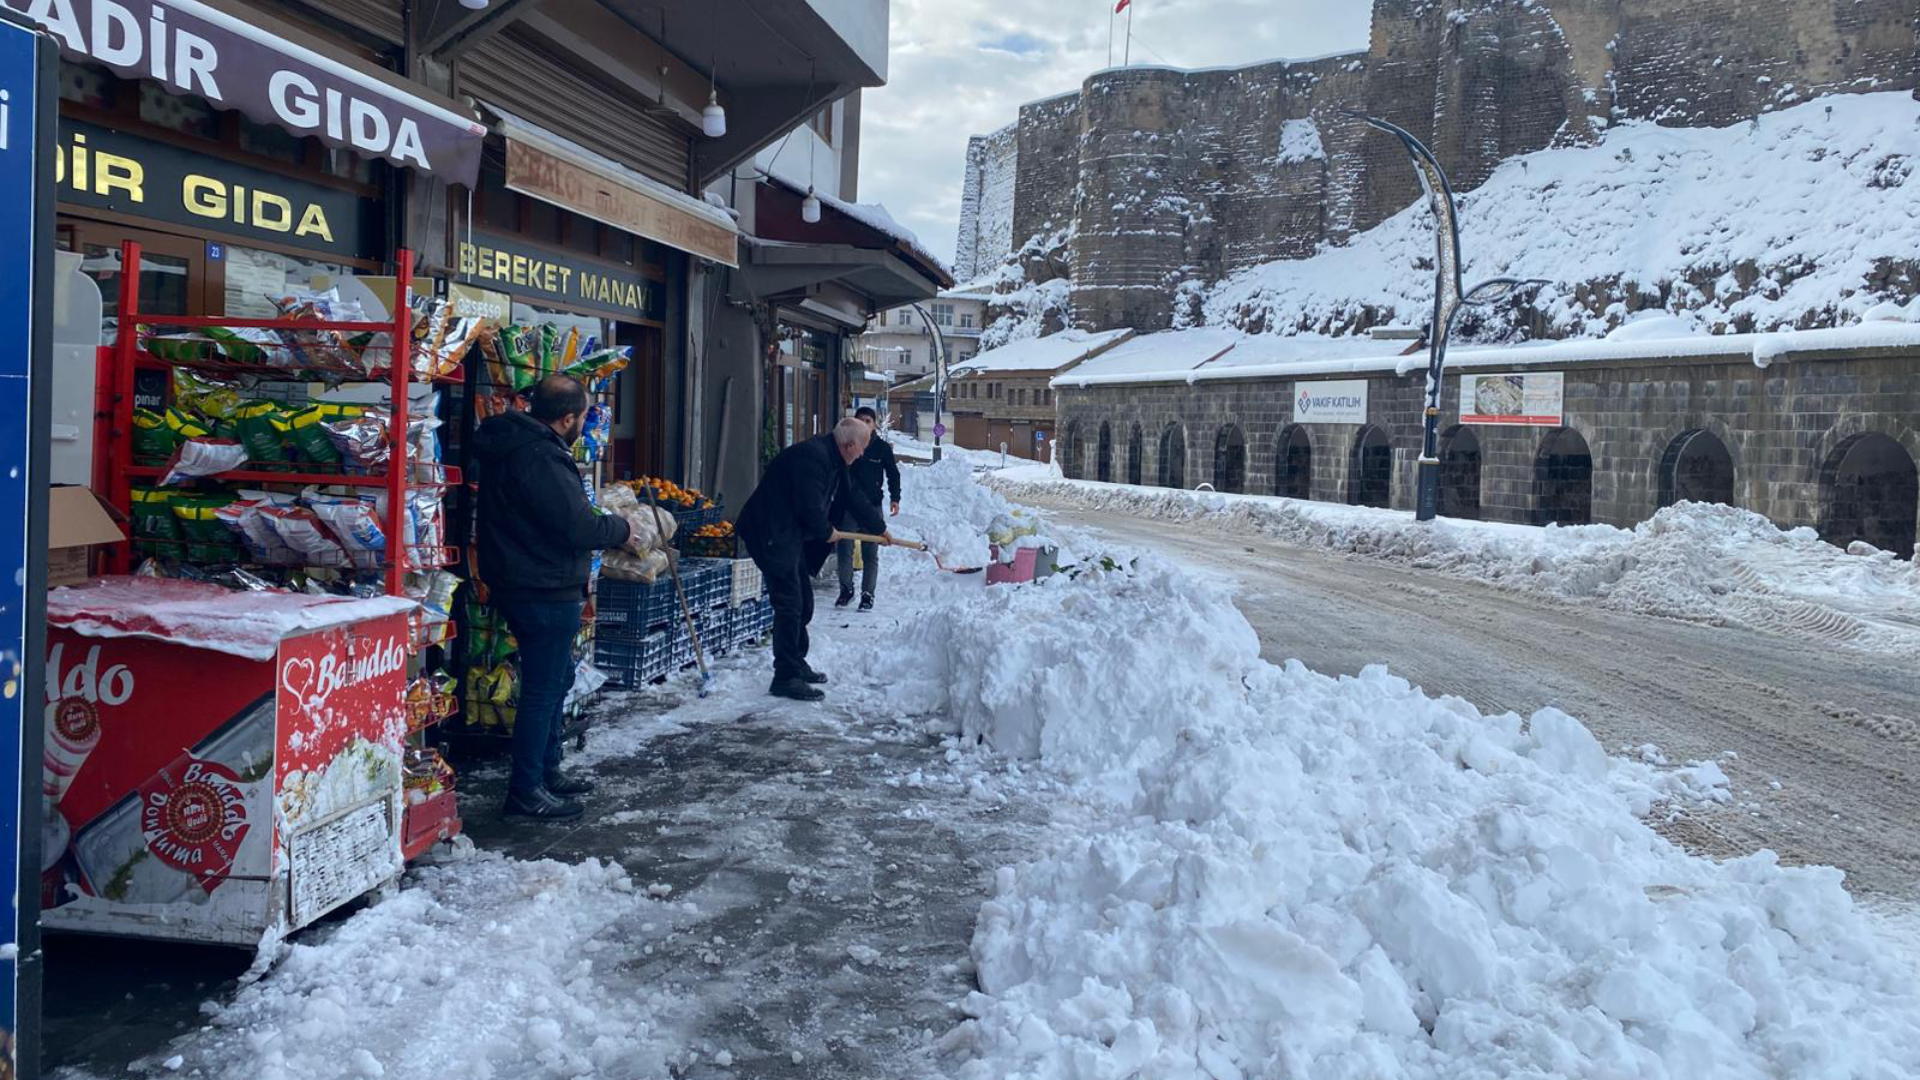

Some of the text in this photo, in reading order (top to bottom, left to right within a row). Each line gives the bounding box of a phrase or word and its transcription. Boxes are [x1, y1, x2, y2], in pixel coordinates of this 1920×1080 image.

[0, 0, 432, 171] ADİR GIDA
[183, 173, 334, 243] GIDA
[211, 246, 220, 258] 23
[460, 241, 571, 295] BEREKET
